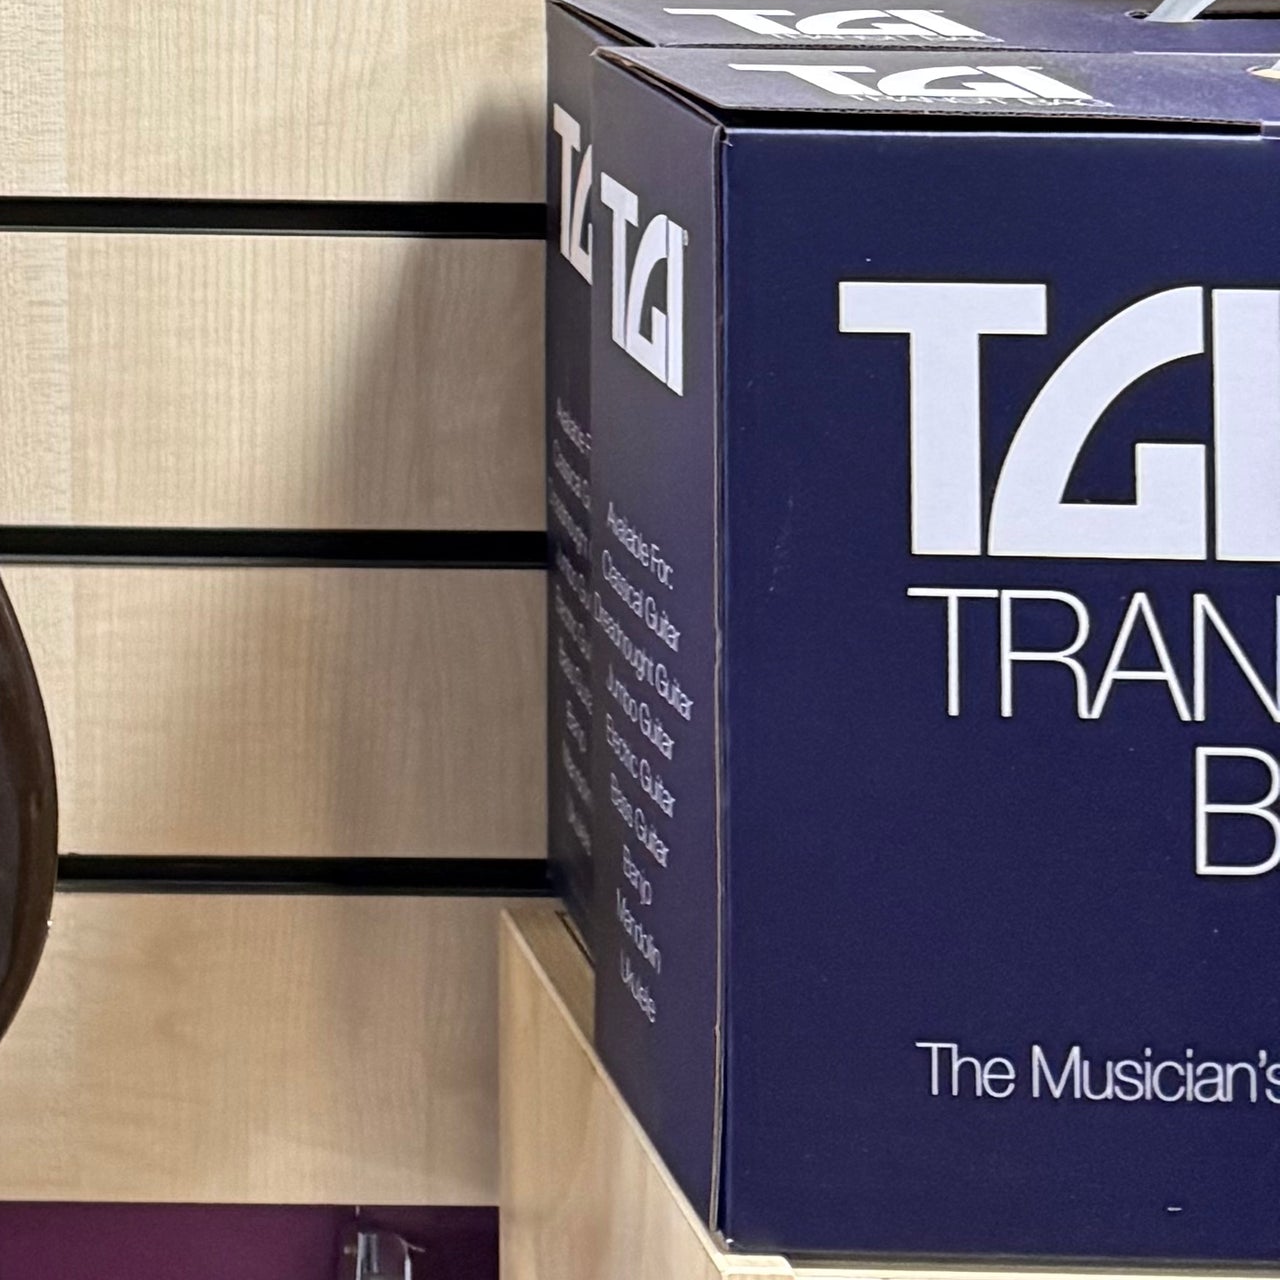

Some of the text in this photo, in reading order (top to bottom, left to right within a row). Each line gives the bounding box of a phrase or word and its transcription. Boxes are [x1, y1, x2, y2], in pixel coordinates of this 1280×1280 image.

[663, 7, 987, 38] TGI
[728, 63, 1094, 100] TGI
[600, 172, 688, 397] TGI
[839, 281, 1280, 562] TGI
[644, 596, 681, 653] Guitar
[907, 587, 1280, 725] TRAN
[655, 663, 694, 721] Guitar
[639, 702, 675, 760] Guitar
[640, 758, 676, 818] Guitar
[1195, 746, 1280, 876] B
[634, 807, 670, 868] Guitar
[915, 1042, 1016, 1098] The
